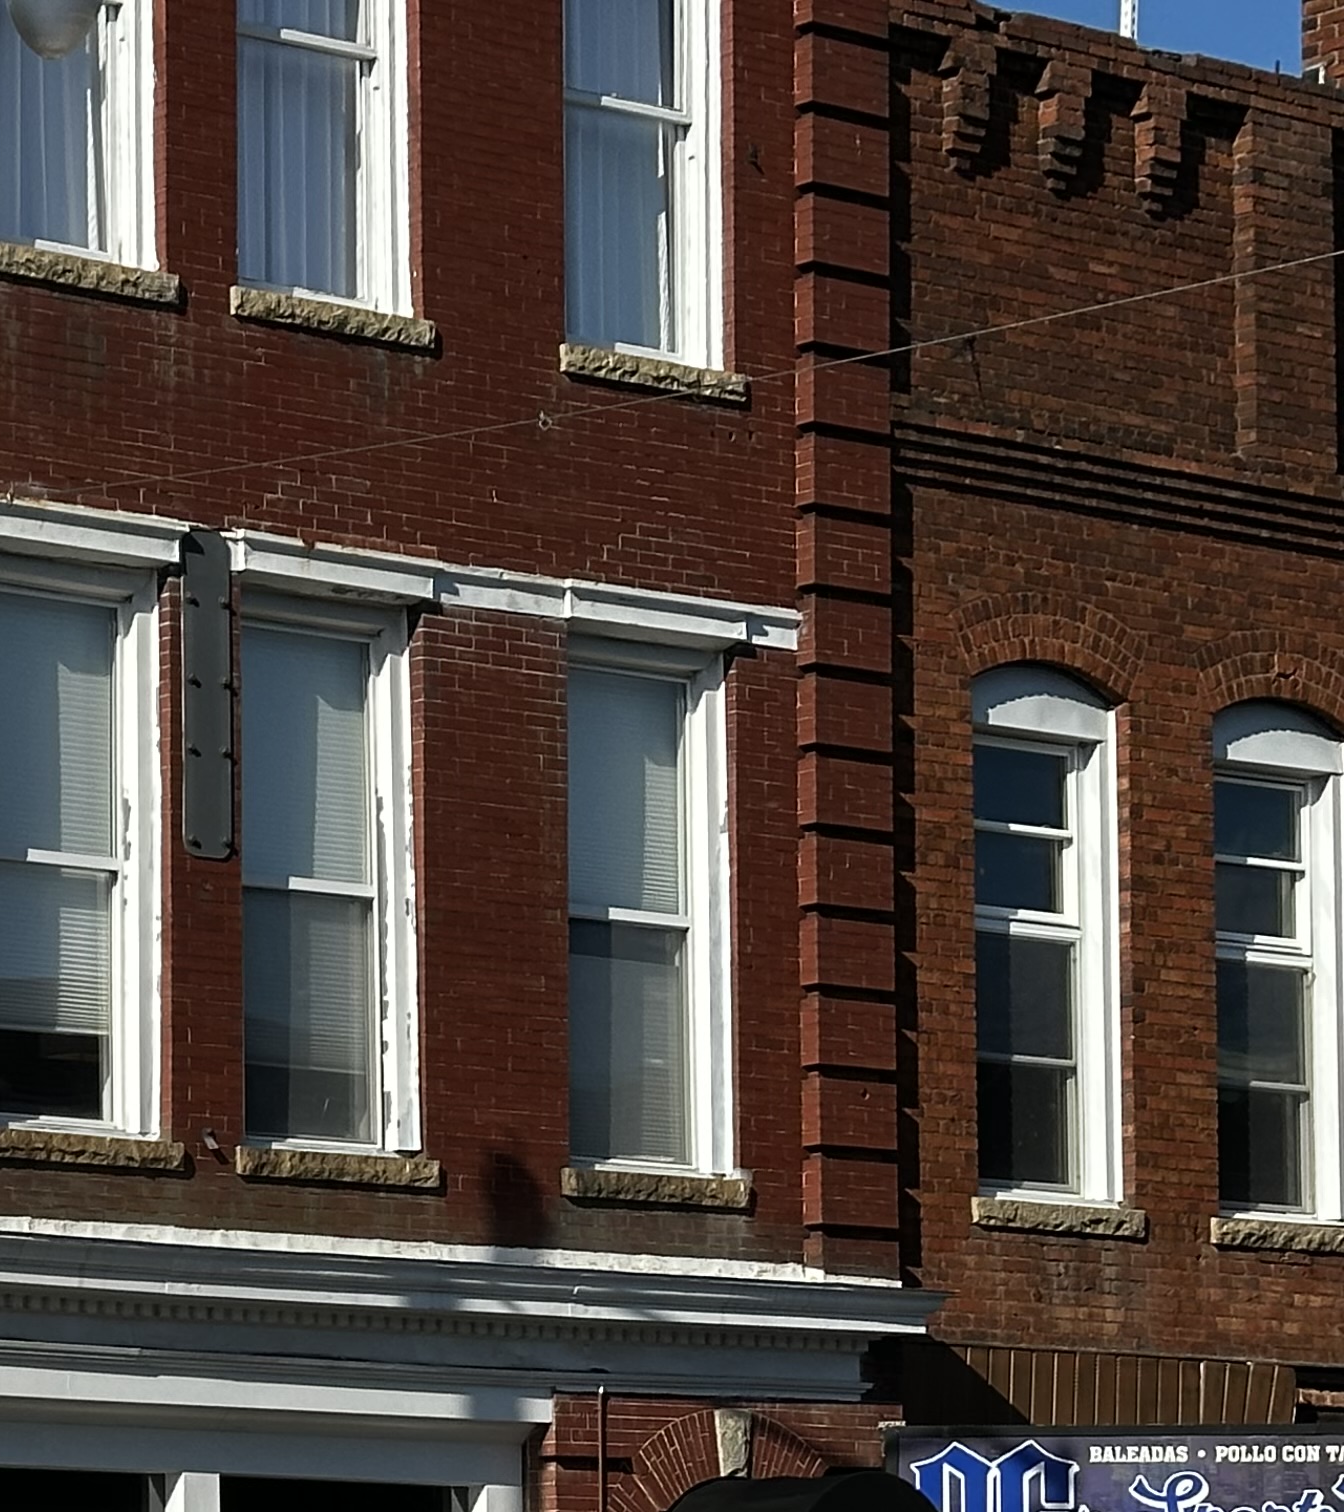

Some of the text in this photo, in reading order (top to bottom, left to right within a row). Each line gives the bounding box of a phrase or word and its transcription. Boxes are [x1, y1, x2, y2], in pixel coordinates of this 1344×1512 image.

[1089, 1446, 1189, 1463] BALEADAS
[1215, 1446, 1277, 1463] POLLO
[1282, 1445, 1321, 1462] CON
